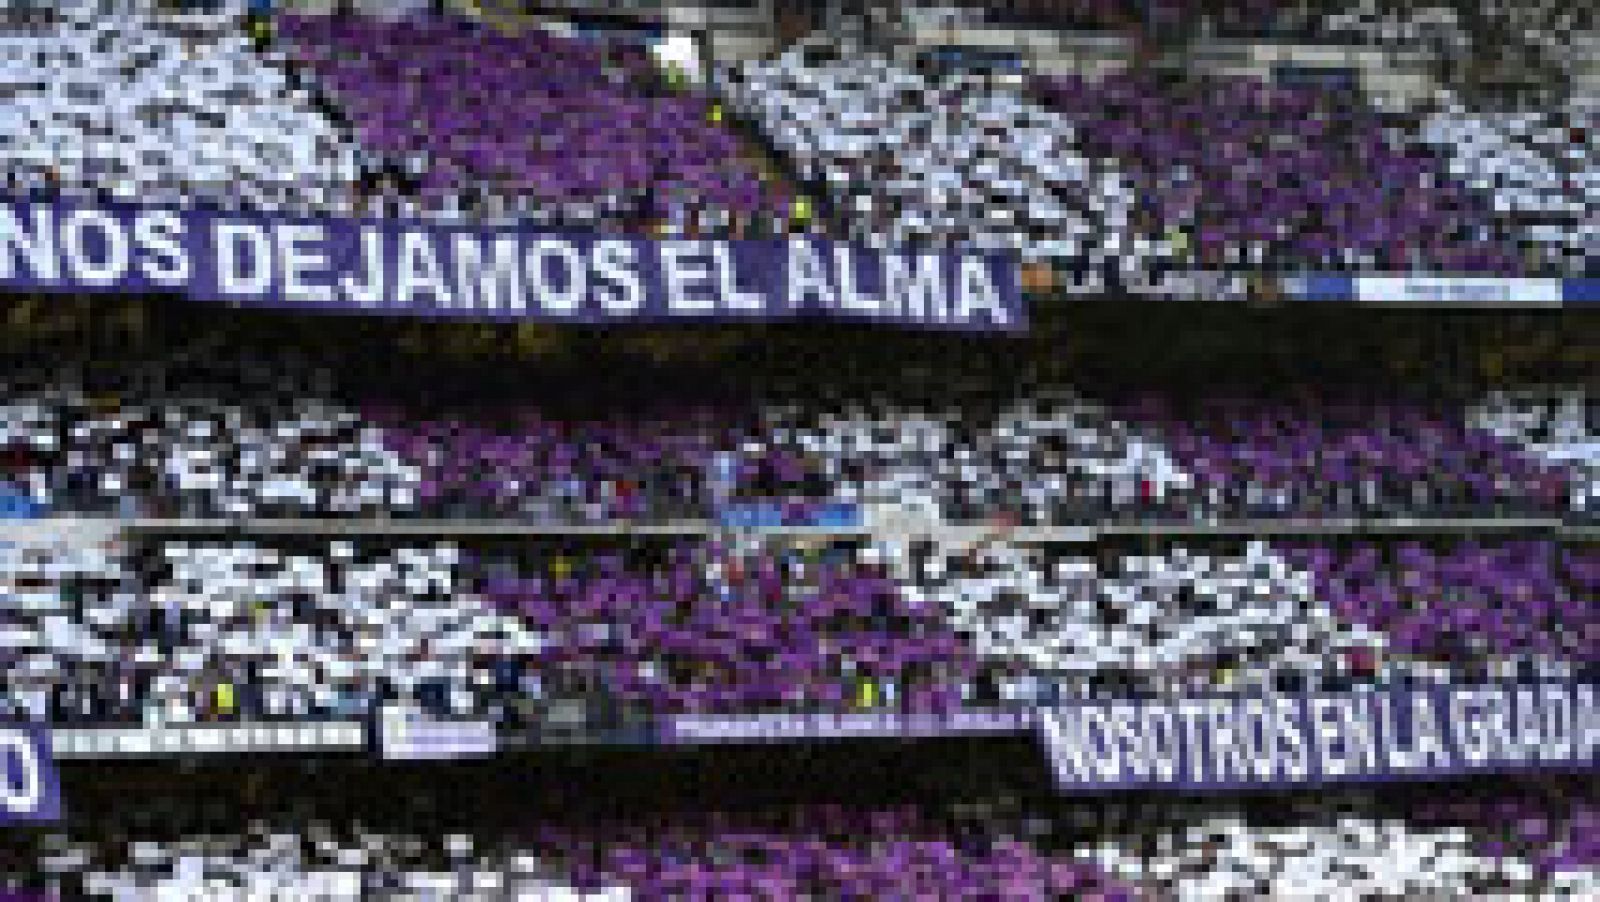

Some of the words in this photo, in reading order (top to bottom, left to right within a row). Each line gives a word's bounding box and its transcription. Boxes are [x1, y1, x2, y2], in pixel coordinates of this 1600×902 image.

[0, 205, 190, 286] NOS
[216, 222, 641, 314] DEJAMOS
[661, 241, 766, 309] EL
[788, 240, 1008, 324] ALMA
[1043, 698, 1307, 782] NOSOTROS
[1314, 697, 1376, 774] EN
[1382, 692, 1450, 768] LA
